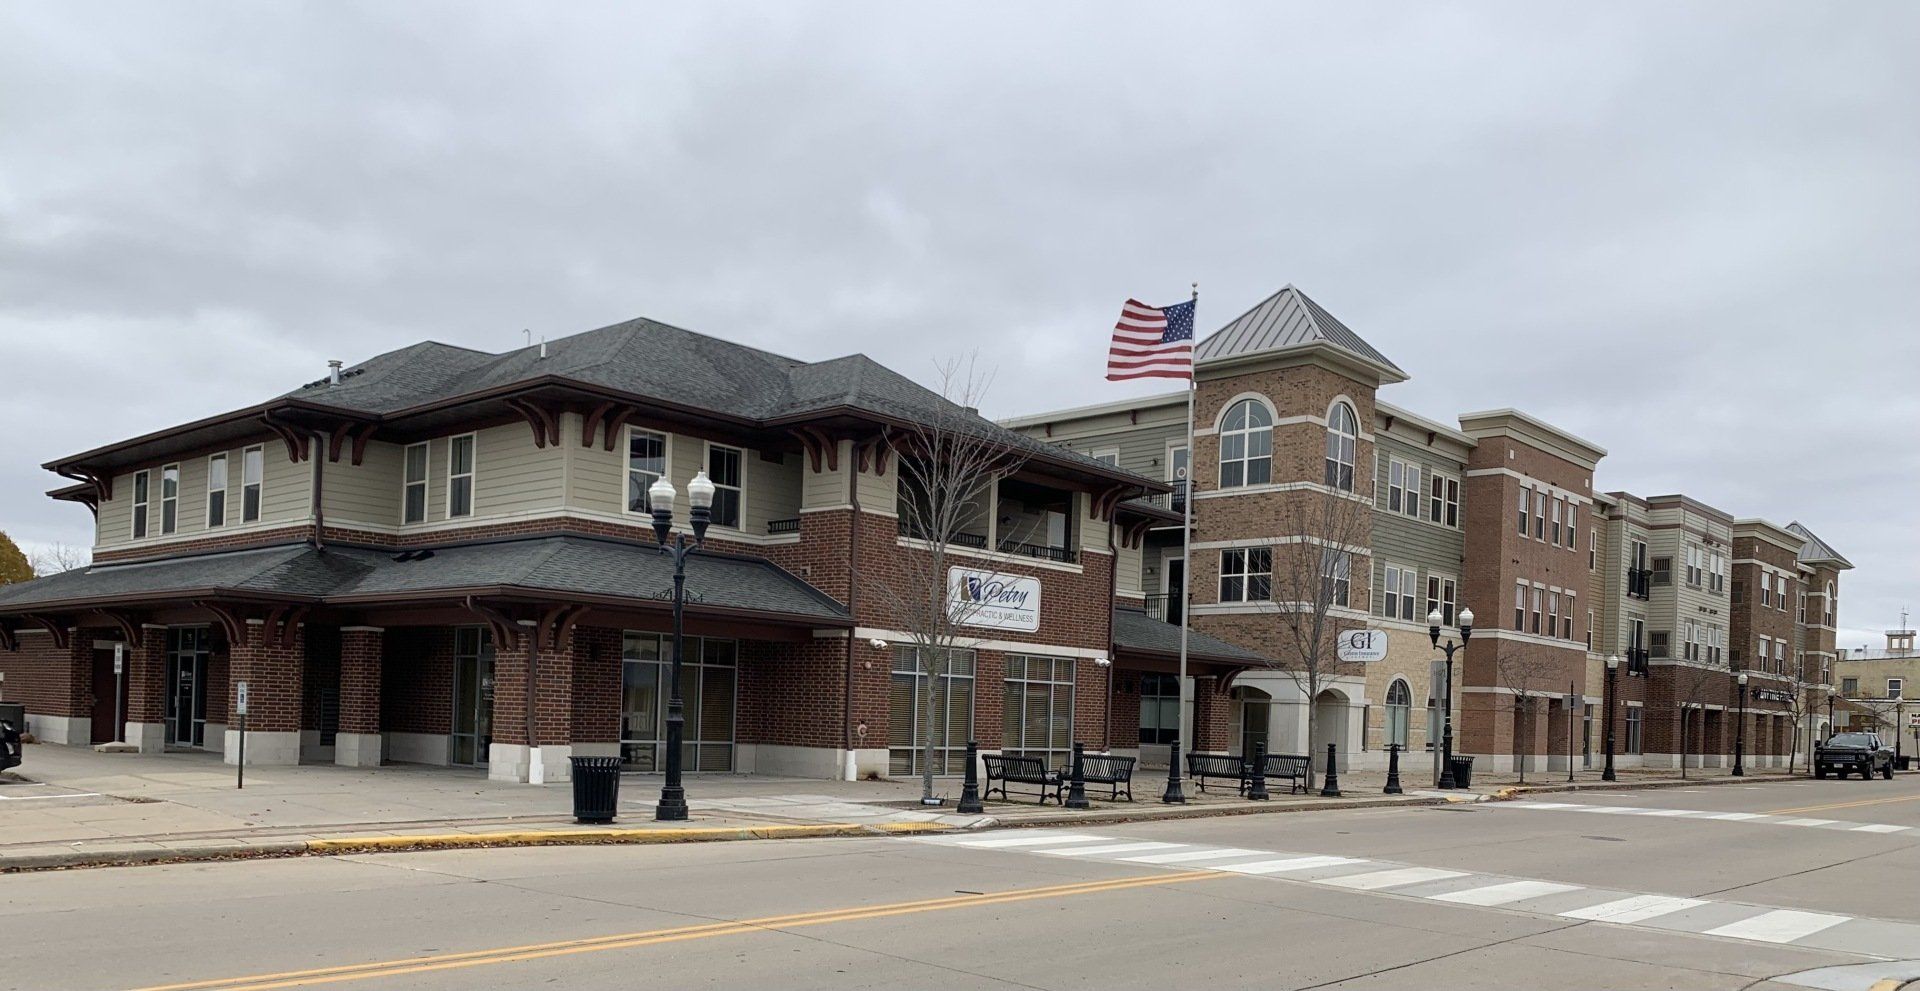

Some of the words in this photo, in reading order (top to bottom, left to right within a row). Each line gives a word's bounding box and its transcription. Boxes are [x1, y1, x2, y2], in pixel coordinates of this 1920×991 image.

[984, 581, 1029, 609] Petry
[1004, 612, 1034, 623] WELLNESS
[1351, 632, 1372, 649] GI
